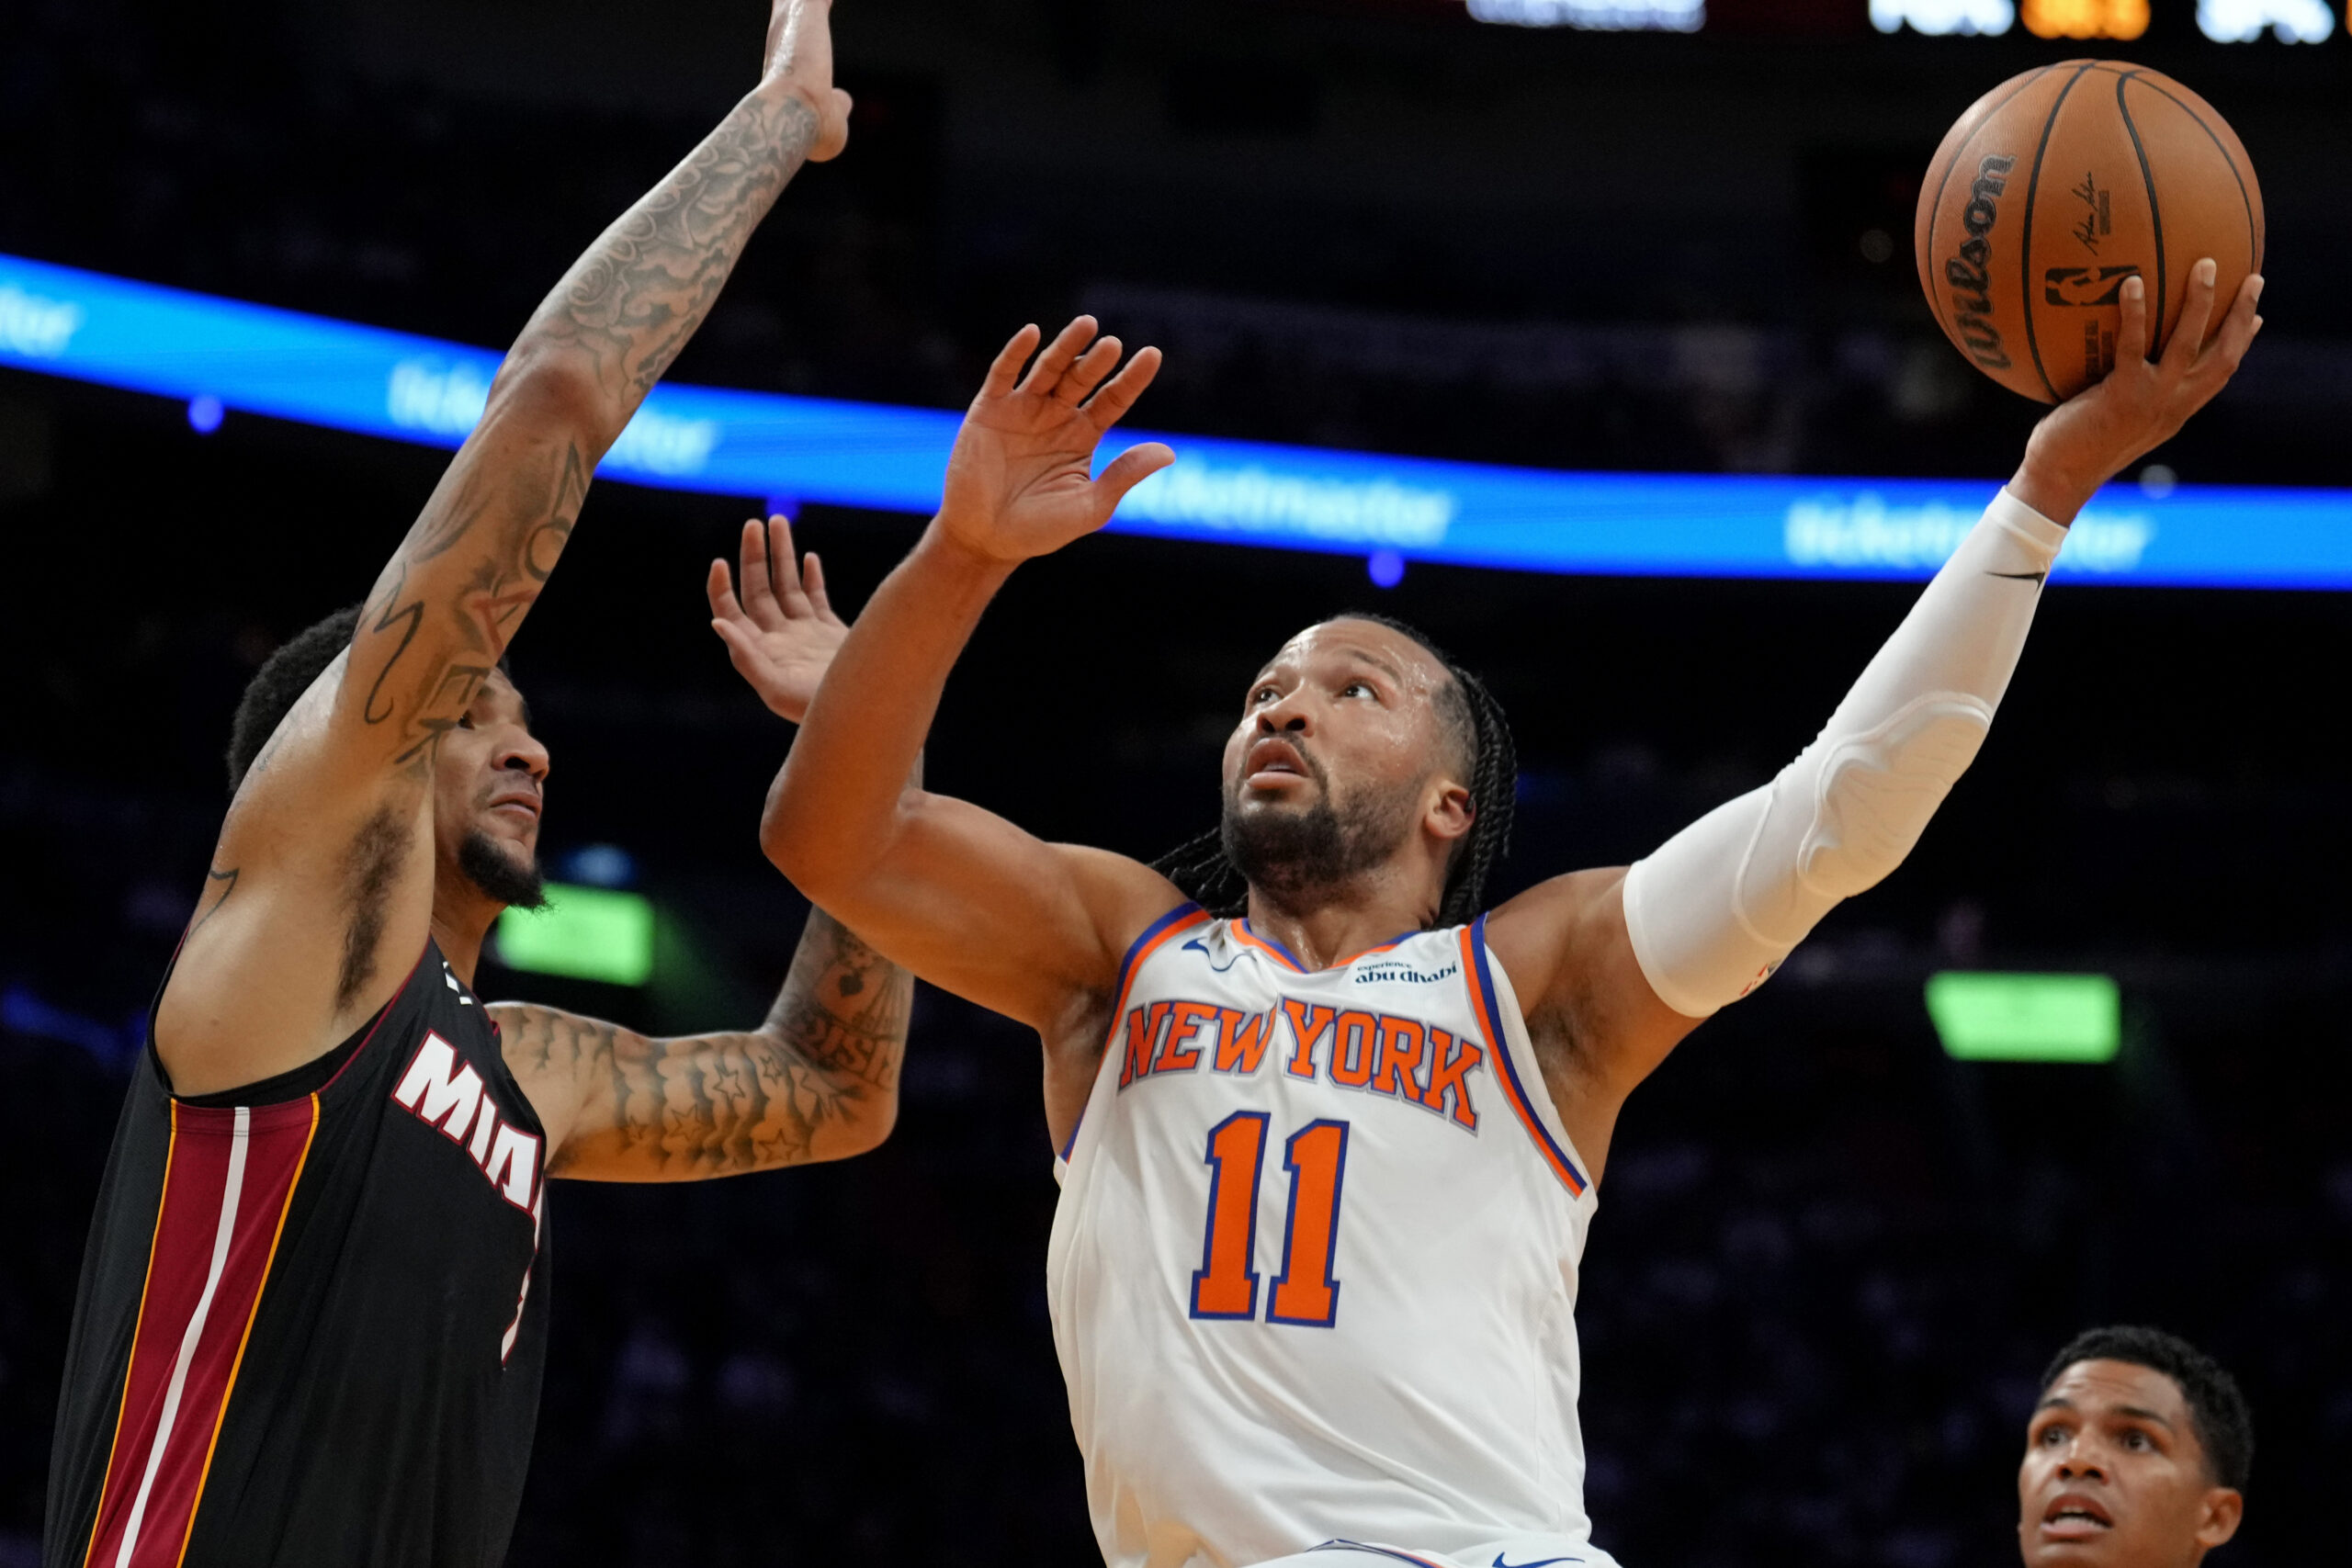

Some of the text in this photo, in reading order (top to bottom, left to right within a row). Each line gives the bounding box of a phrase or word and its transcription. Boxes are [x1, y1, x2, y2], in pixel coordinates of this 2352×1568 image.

[1945, 153, 2018, 369] Wilson
[1355, 961, 1457, 984] abu dhabi
[1357, 961, 1412, 971] experience
[390, 1028, 544, 1222] MIA
[1117, 993, 1486, 1138] NEW YORK
[1189, 1110, 1351, 1328] 11
